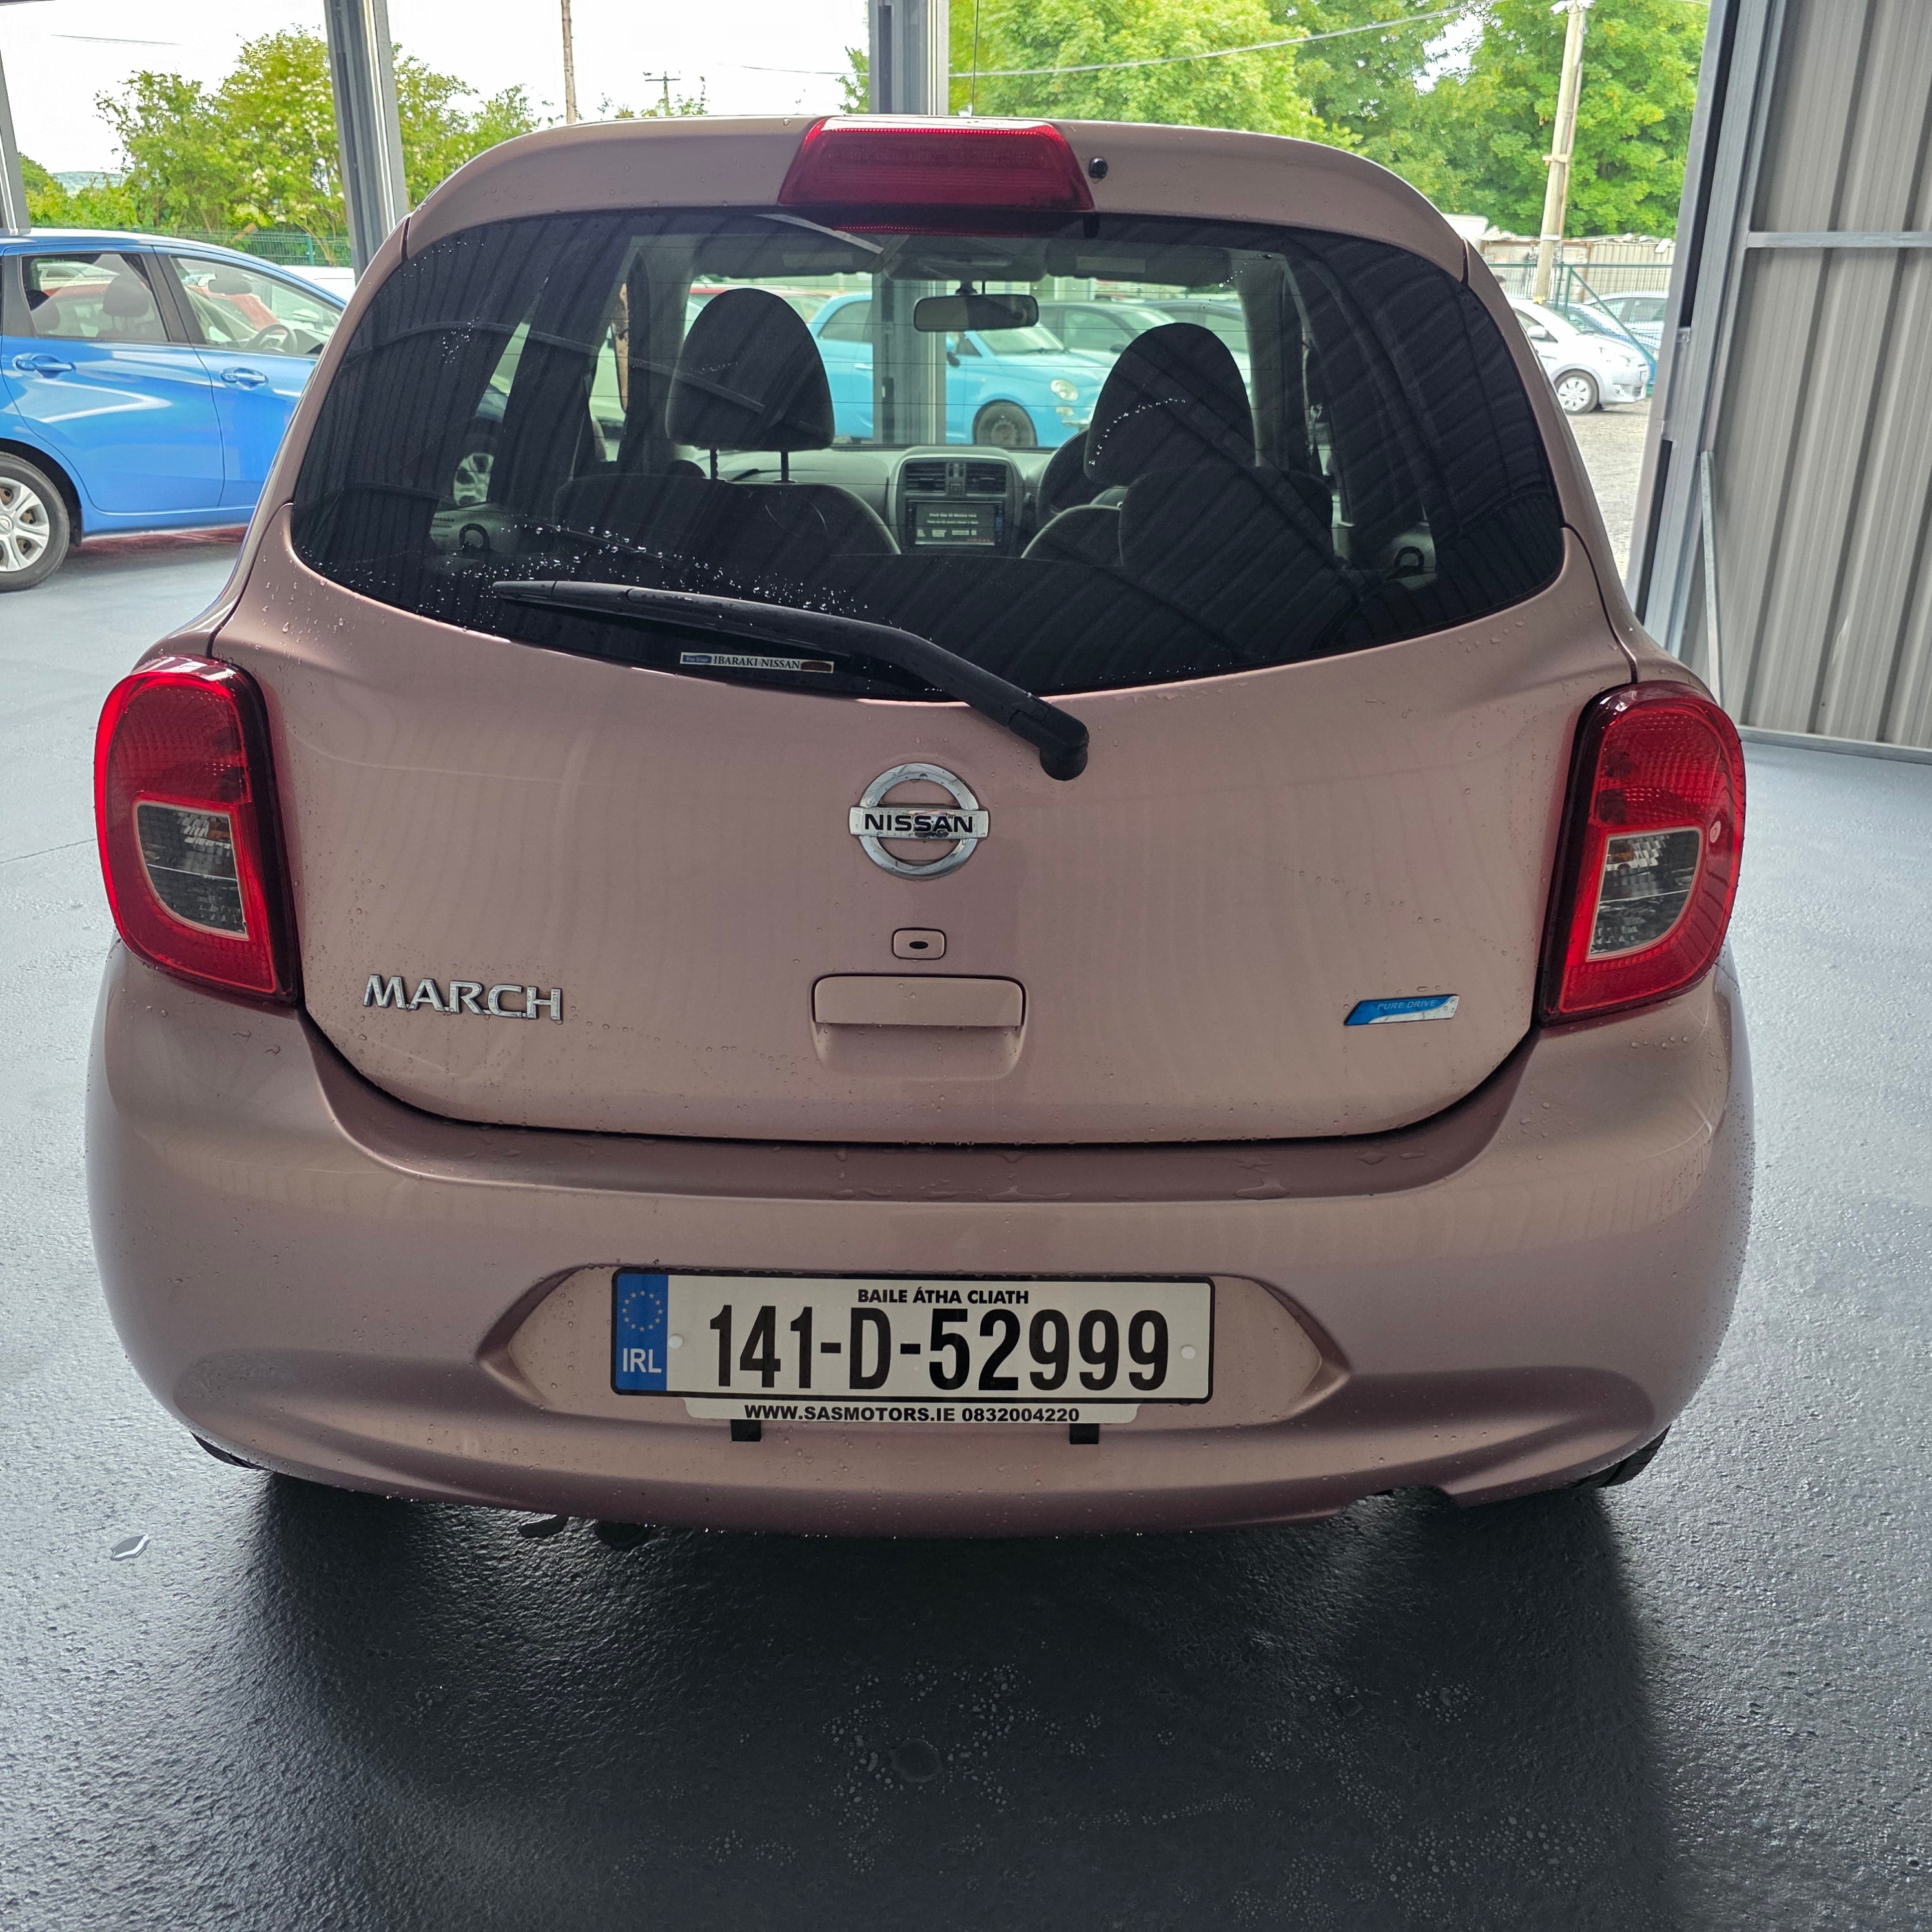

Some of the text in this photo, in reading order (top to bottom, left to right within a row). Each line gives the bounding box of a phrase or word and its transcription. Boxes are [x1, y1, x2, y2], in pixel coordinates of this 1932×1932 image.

[713, 656, 758, 666] IBARAKI
[761, 659, 801, 669] NISSAN
[865, 814, 973, 833] NISSAN
[362, 974, 562, 1021] MARCH
[1377, 1000, 1437, 1011] PURE DRIVE
[858, 1286, 1029, 1304] BAILE ÁTHA CLIATH
[710, 1304, 1169, 1392] 141-D-52999
[622, 1348, 663, 1373] IRL
[744, 1404, 1080, 1422] WWW.SASMOTORS.IE 0832004220
